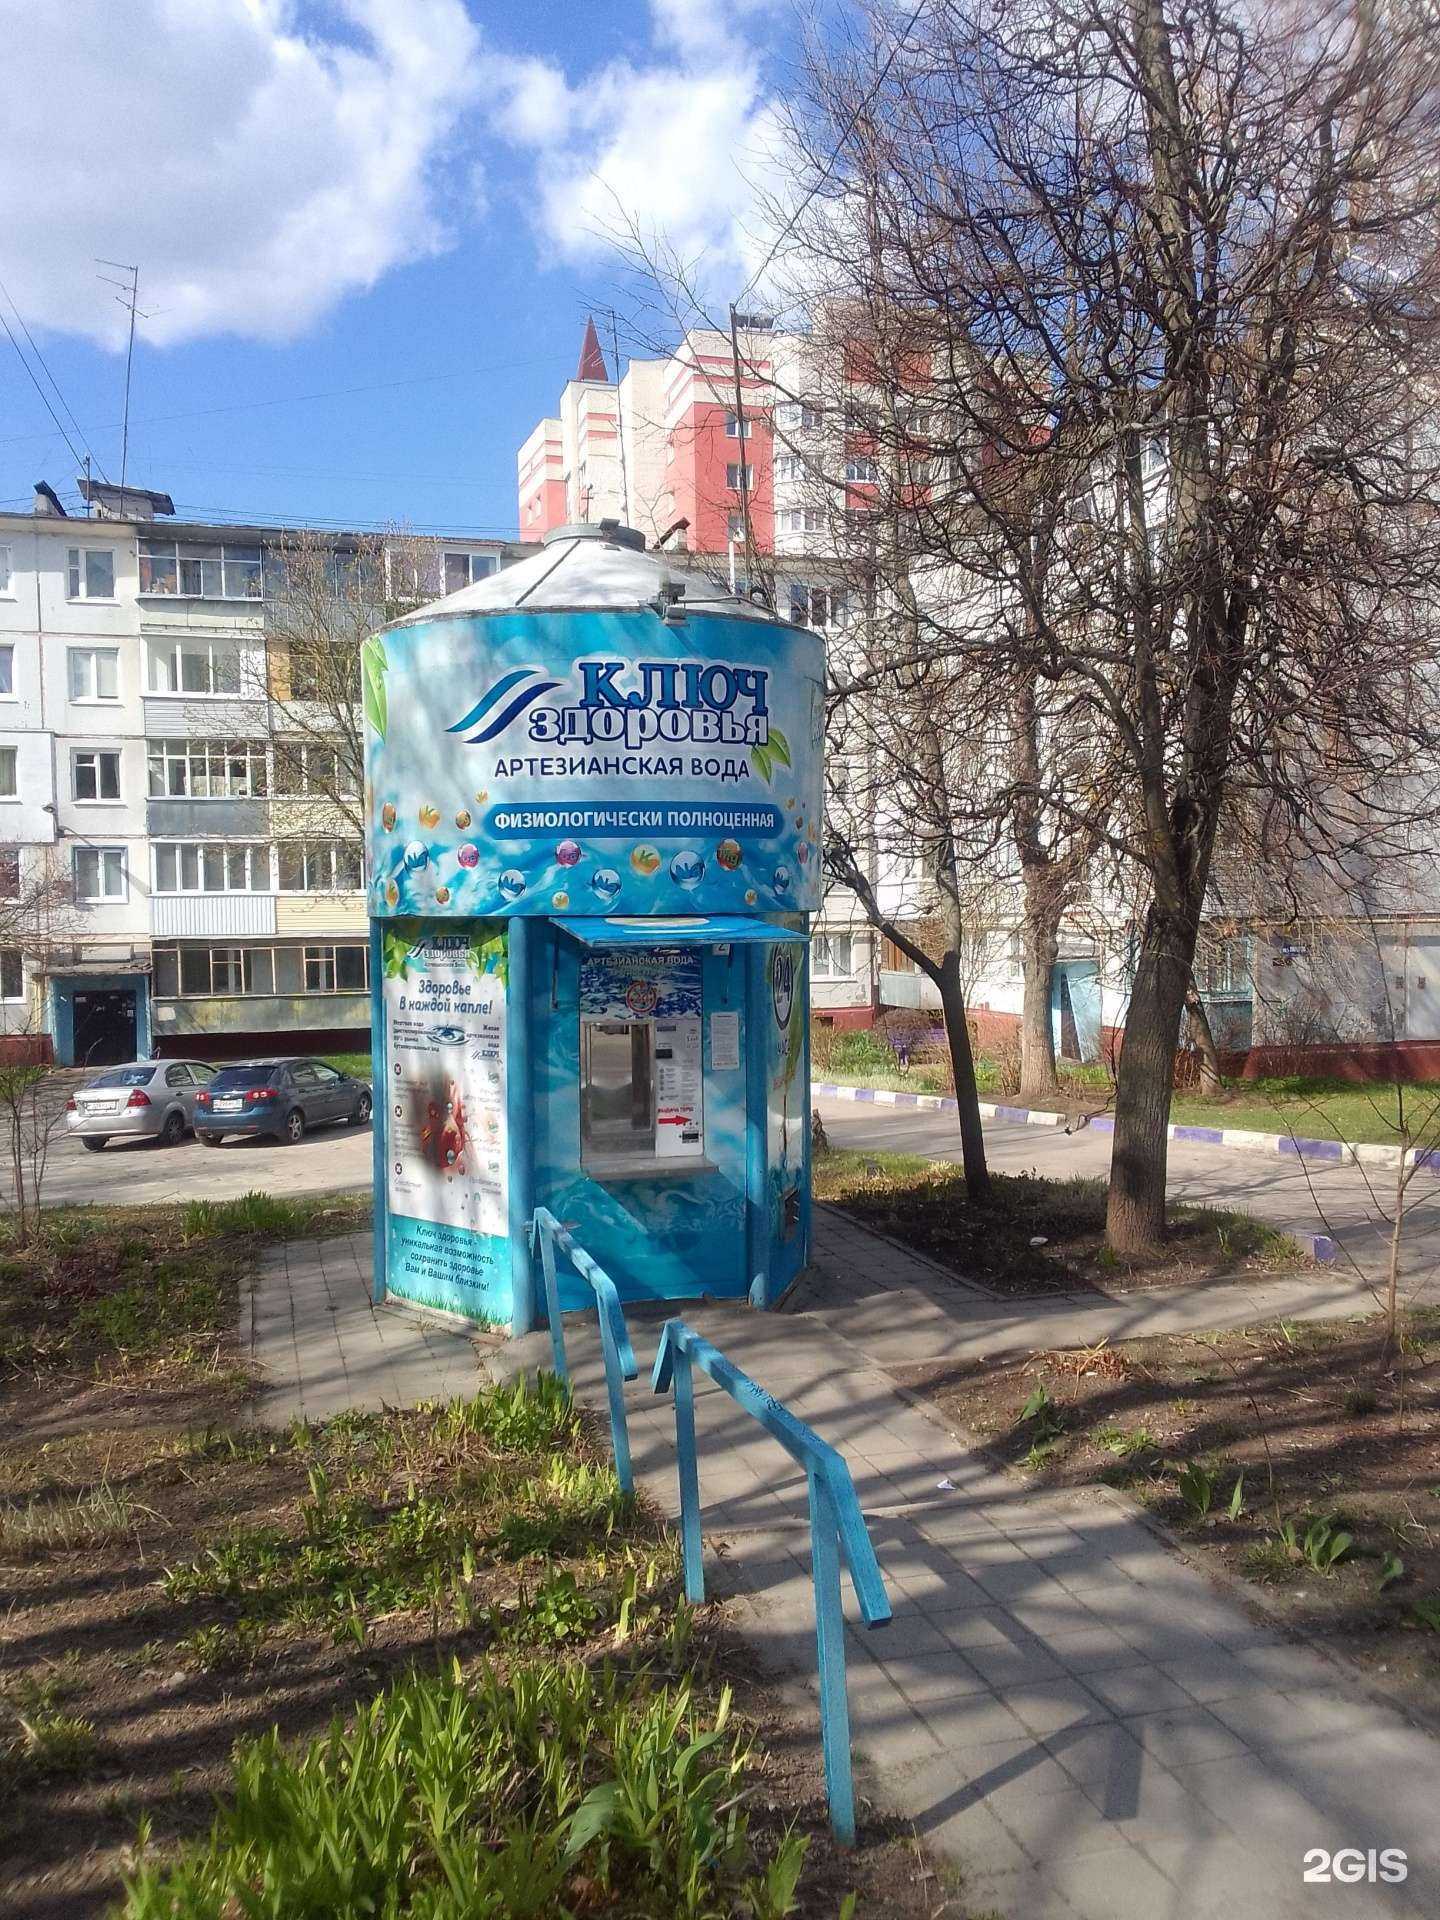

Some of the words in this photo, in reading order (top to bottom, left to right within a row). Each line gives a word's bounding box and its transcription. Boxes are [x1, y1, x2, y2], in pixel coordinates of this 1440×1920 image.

[578, 662, 768, 715] КЛЮЧ
[494, 756, 684, 778] АРТЕЗИАНСКАЯ
[691, 758, 750, 782] ВОДА
[494, 811, 662, 830] ФИЗИОЛОГИЧЕСКИ
[667, 811, 774, 830] ПОЛНОЦЕННАЯ
[587, 956, 665, 967] АРТЕЗИАНСКАЯ
[667, 956, 694, 965] ВОДА
[419, 979, 471, 998] Здоровье
[408, 998, 451, 1012] каждой
[454, 1000, 493, 1014] капле!
[416, 1225, 436, 1237] Ключ
[438, 1232, 473, 1246] здоровья
[400, 1238, 443, 1253] уникальная
[444, 1247, 494, 1264] возможность
[410, 1252, 448, 1267] сохранить
[450, 1261, 484, 1276] здоровье
[405, 1262, 419, 1274] Вам
[428, 1268, 453, 1281] Вашим
[455, 1274, 489, 1291] близким!
